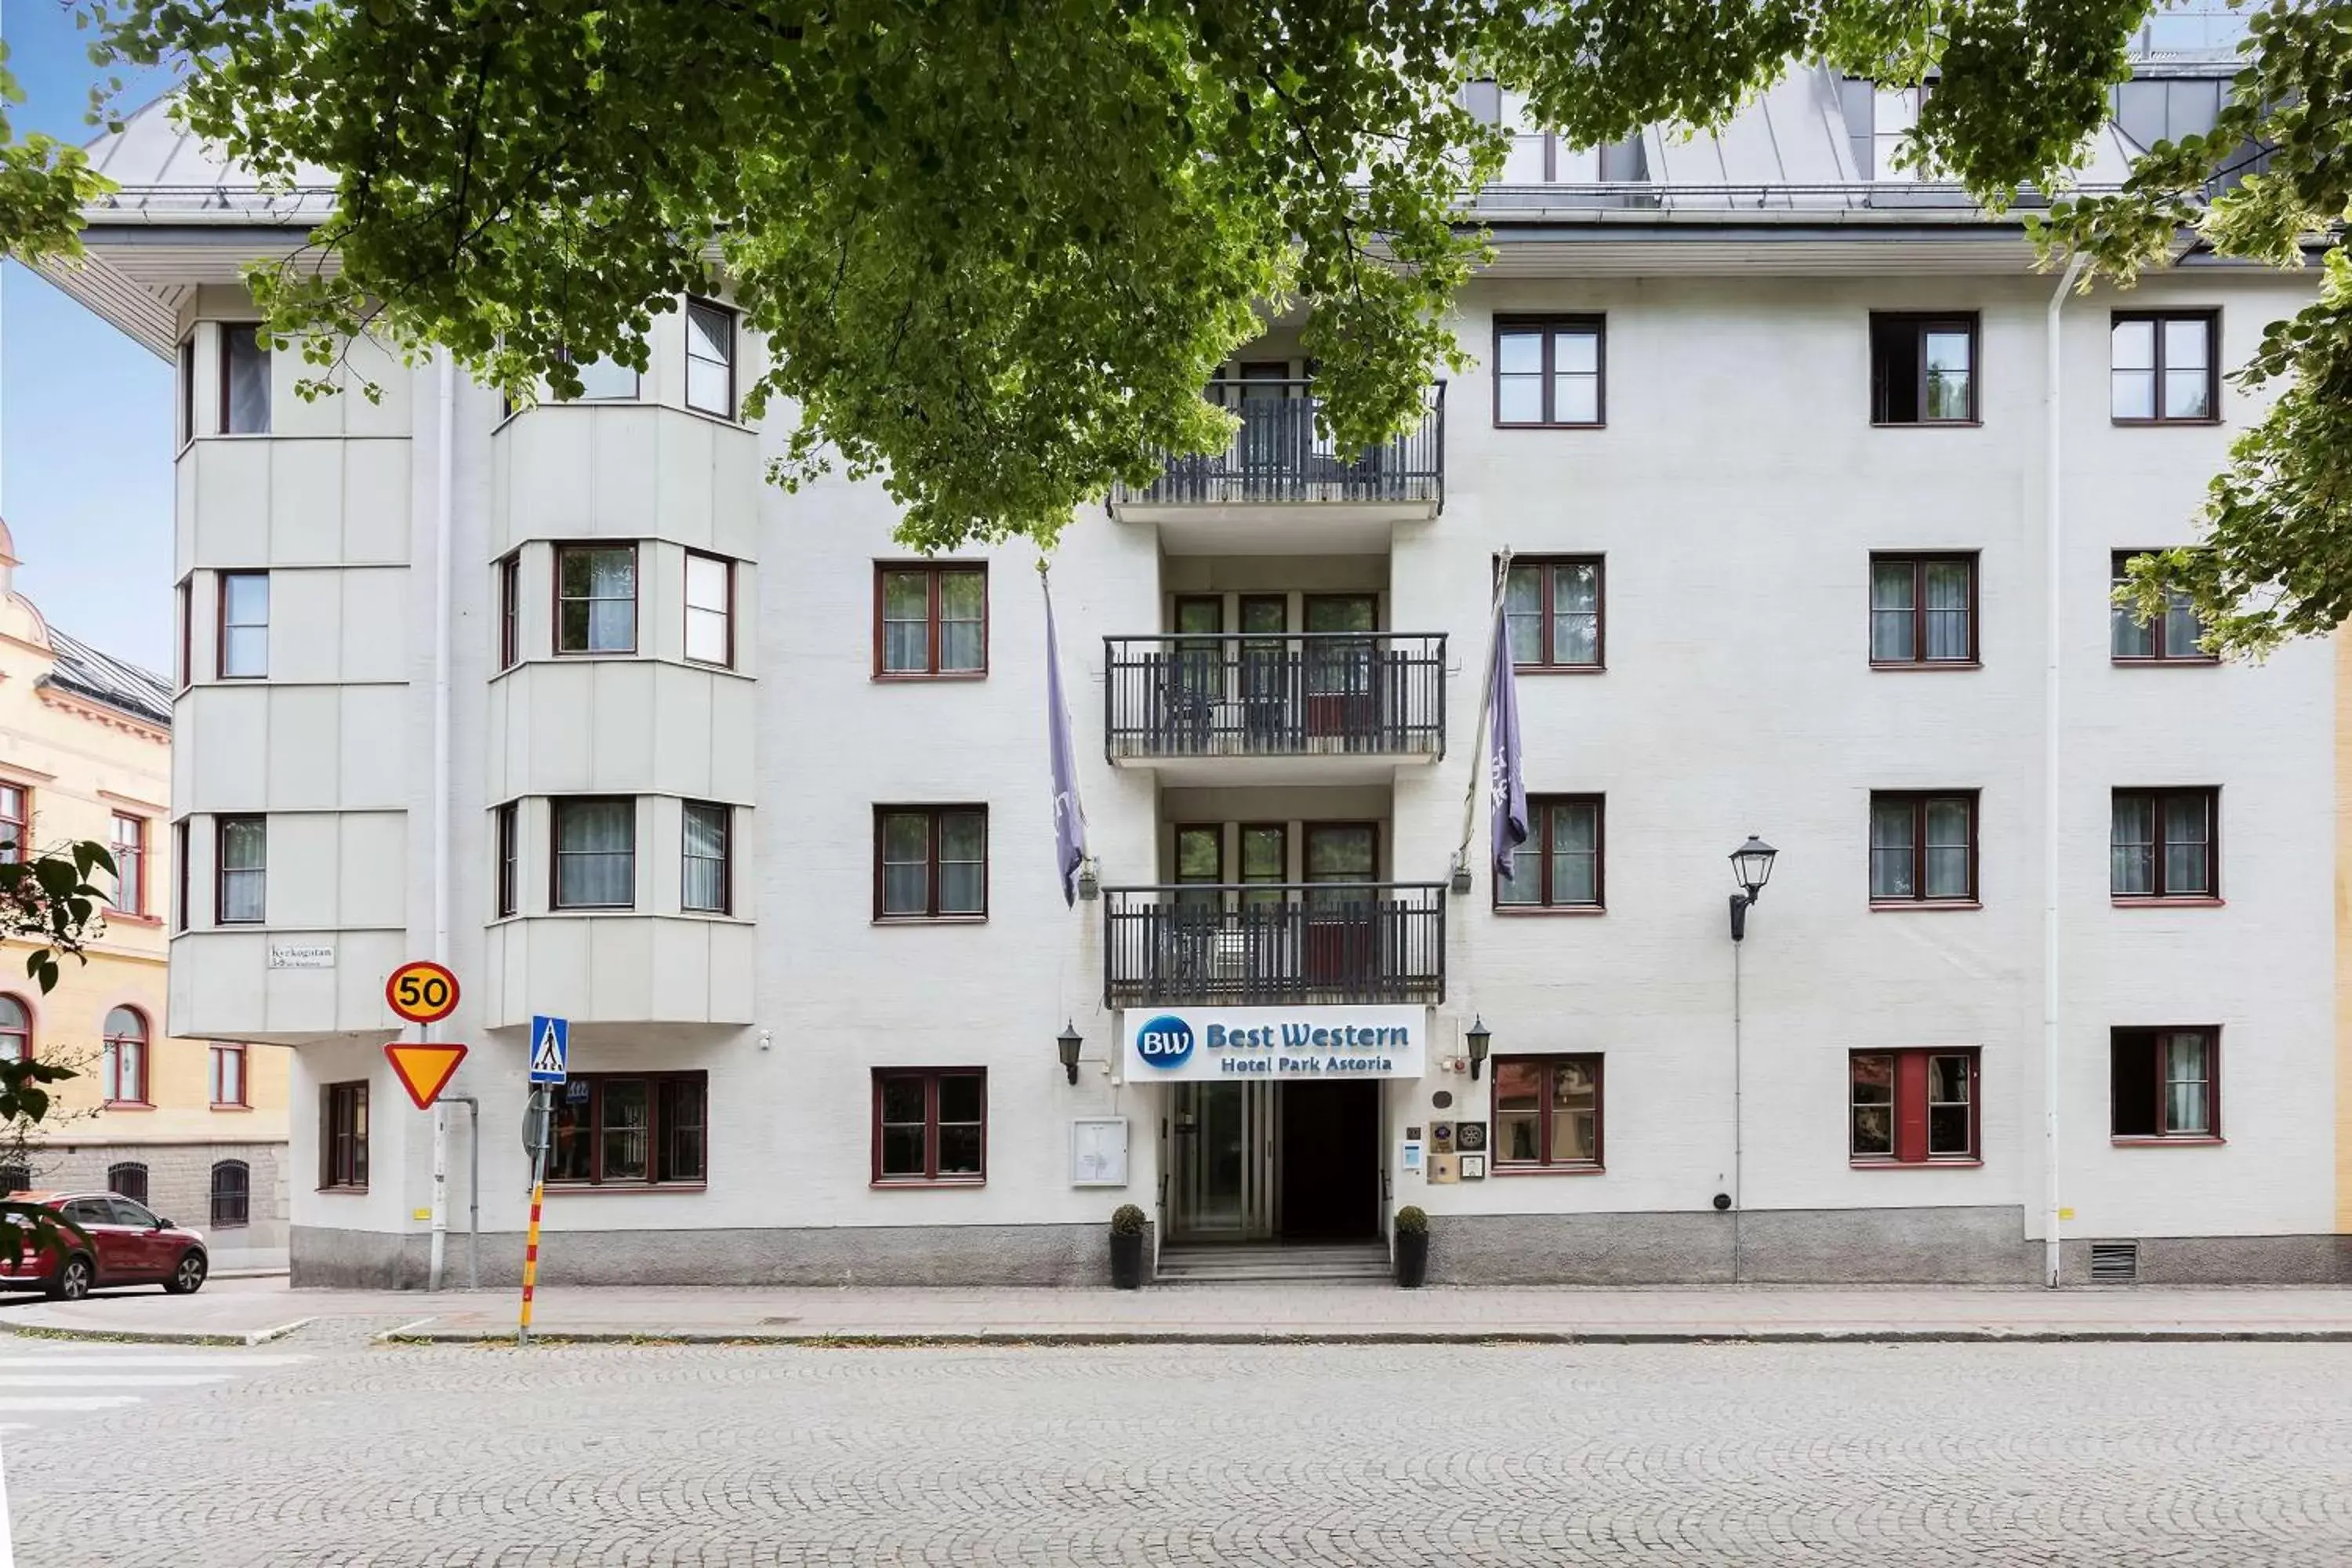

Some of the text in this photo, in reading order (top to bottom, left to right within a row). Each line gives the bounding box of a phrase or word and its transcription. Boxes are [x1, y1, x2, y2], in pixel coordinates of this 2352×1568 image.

[400, 977, 448, 1007] 50
[1144, 1033, 1189, 1054] BW
[1207, 1023, 1409, 1048] Best Western
[1221, 1056, 1392, 1072] Hotel Park Astoria
